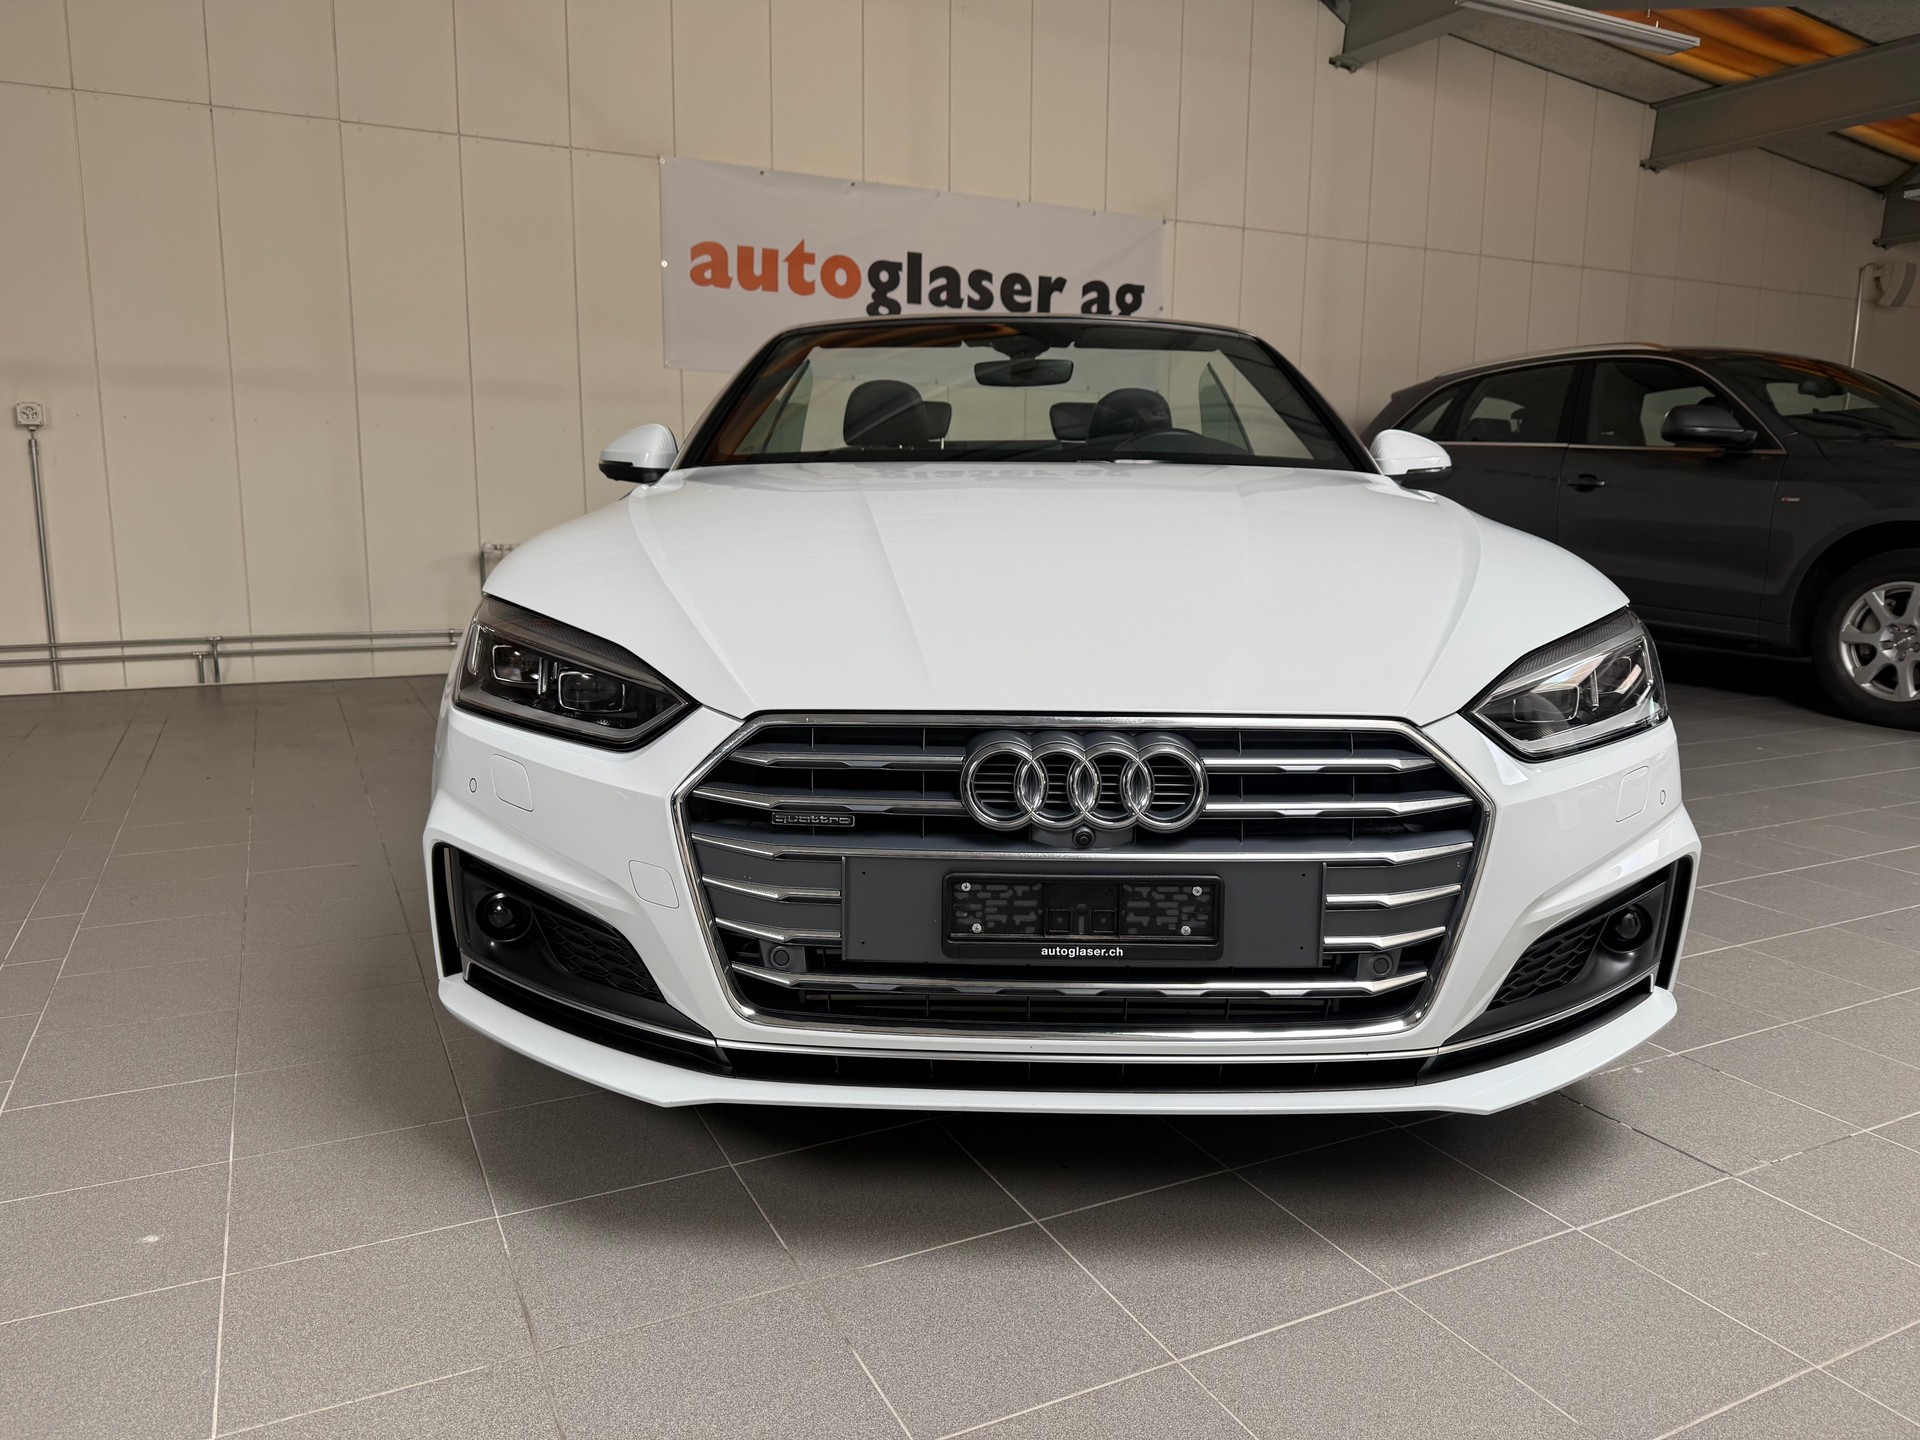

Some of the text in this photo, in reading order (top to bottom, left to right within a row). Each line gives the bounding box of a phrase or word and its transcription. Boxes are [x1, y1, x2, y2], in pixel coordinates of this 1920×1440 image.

[689, 238, 1067, 317] autoglaser
[775, 814, 851, 824] quattro
[1041, 946, 1124, 958] autoglaser.ch
